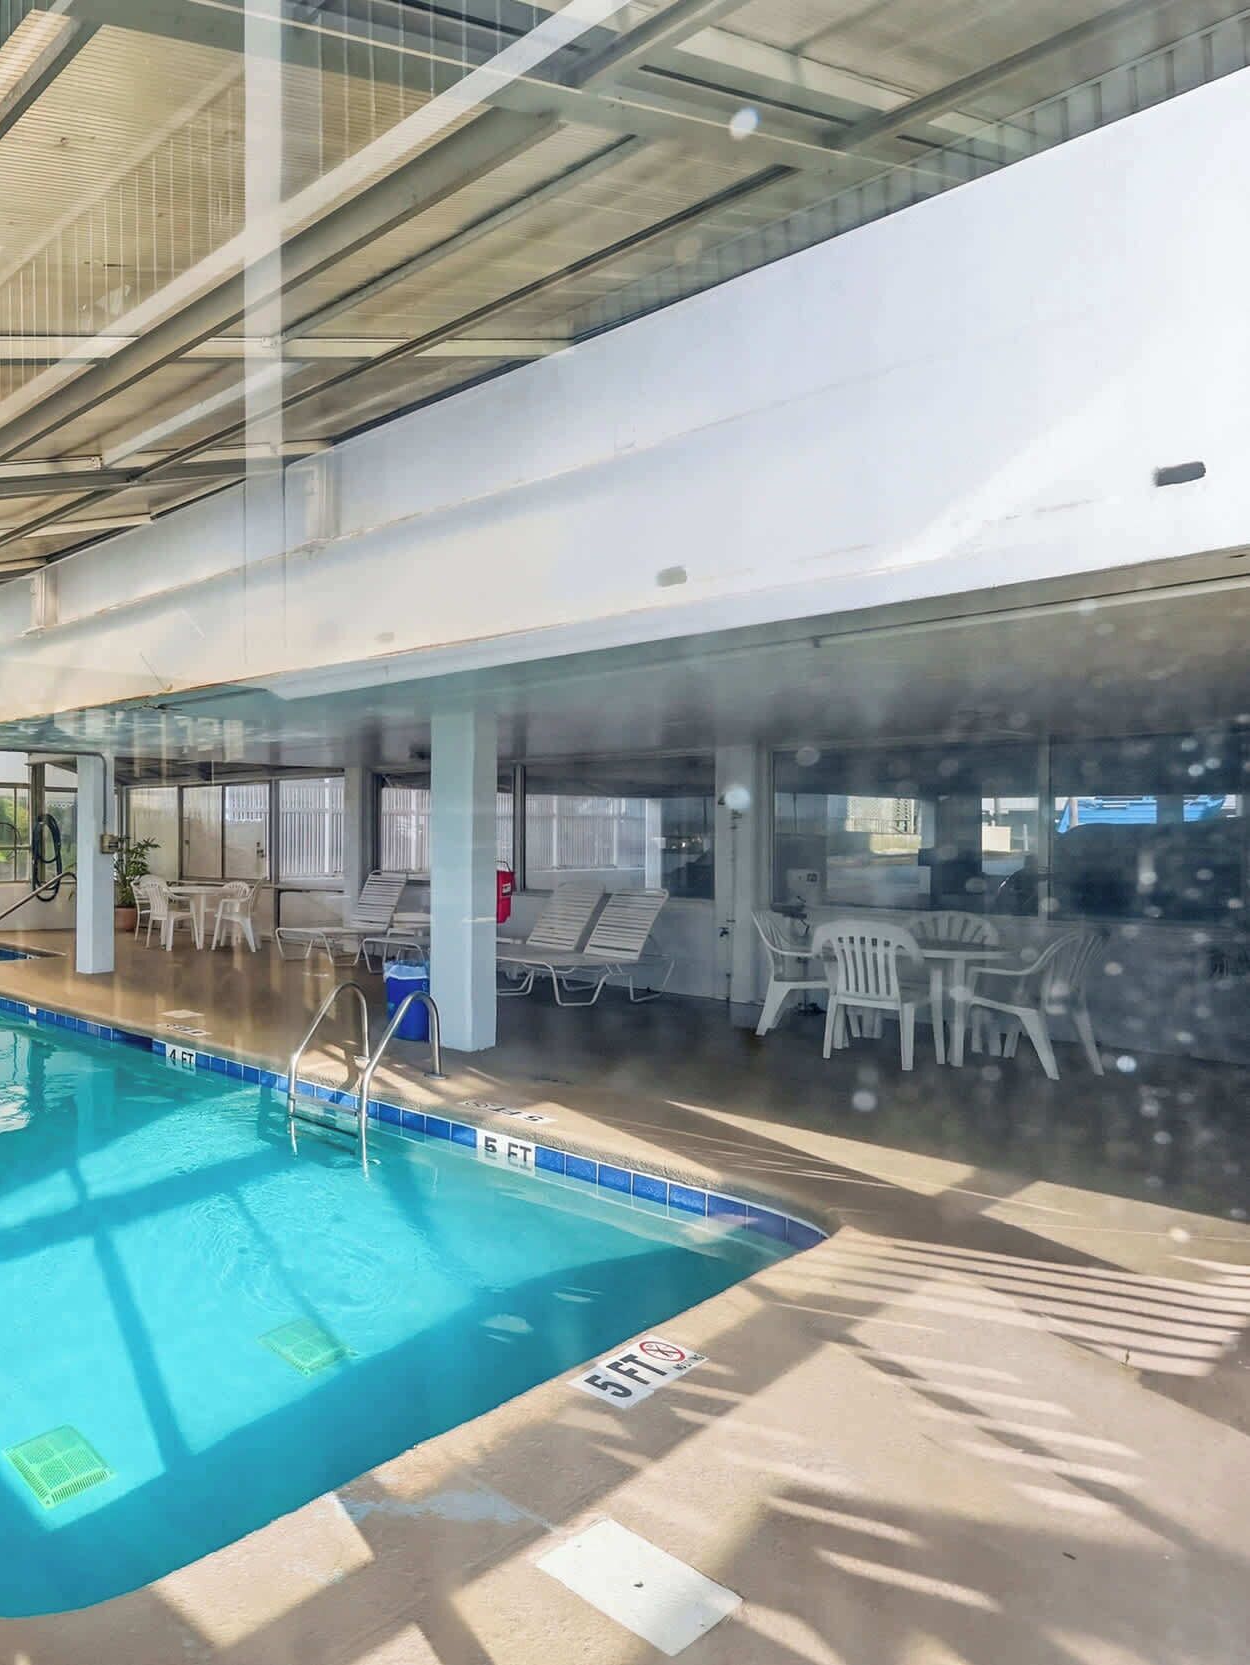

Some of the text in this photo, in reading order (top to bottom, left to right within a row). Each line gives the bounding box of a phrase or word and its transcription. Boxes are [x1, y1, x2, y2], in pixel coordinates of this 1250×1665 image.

[169, 1049, 194, 1064] 4 FT
[484, 1135, 532, 1162] 5 FT
[606, 1353, 668, 1385] FT
[583, 1374, 633, 1398] 5
